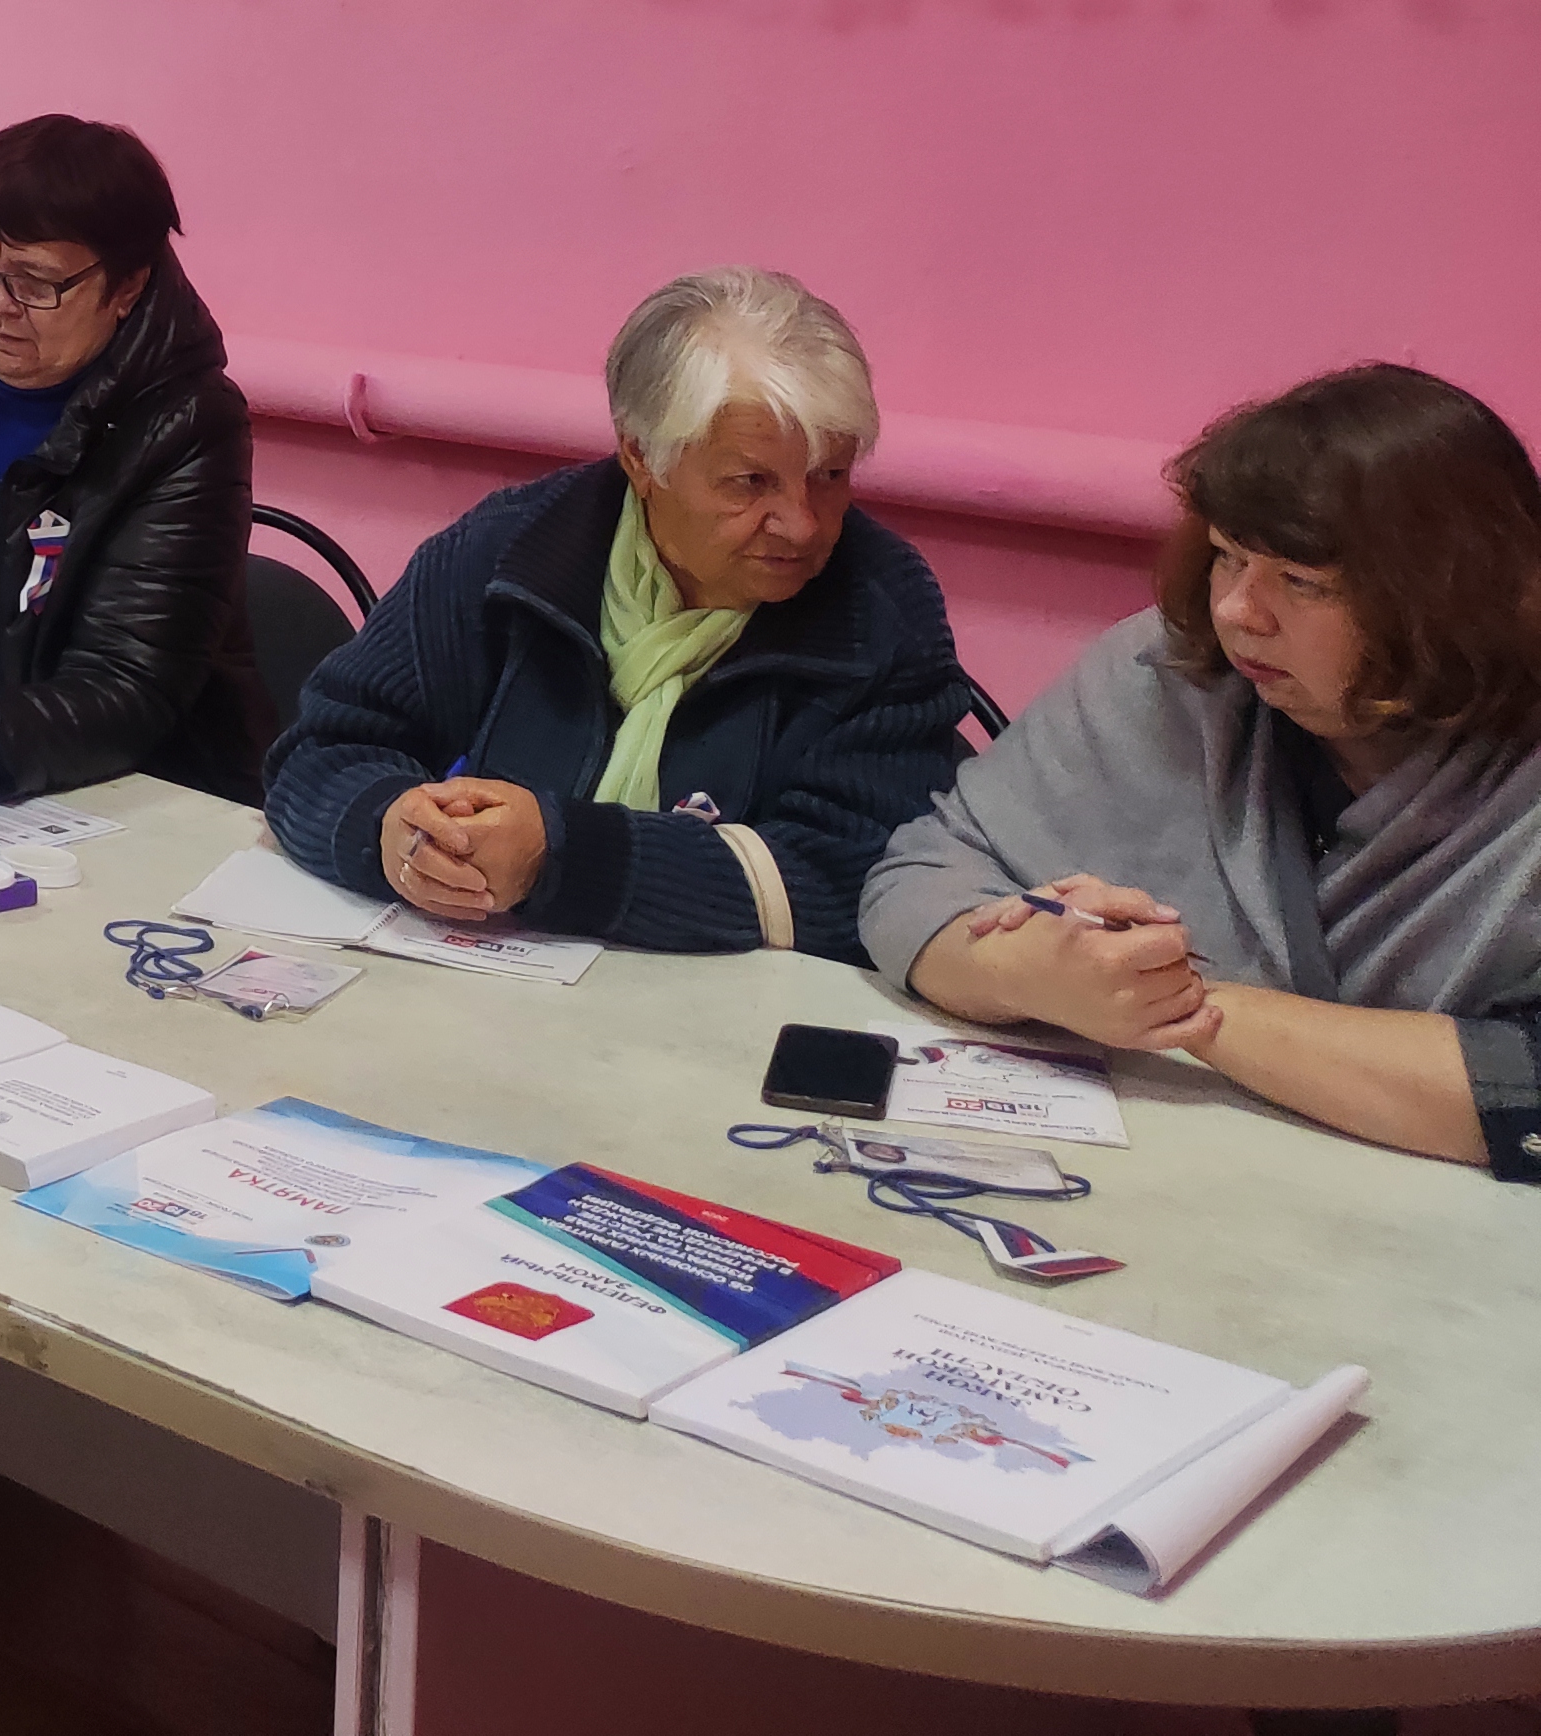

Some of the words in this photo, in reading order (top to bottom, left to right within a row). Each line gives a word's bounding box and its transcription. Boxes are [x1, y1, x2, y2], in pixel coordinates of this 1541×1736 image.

[227, 1167, 352, 1215] ПАМЯТКА
[499, 1253, 668, 1315] ФЕДЕРАЛЬНЫЙ
[554, 1262, 633, 1291] ЗАКОН
